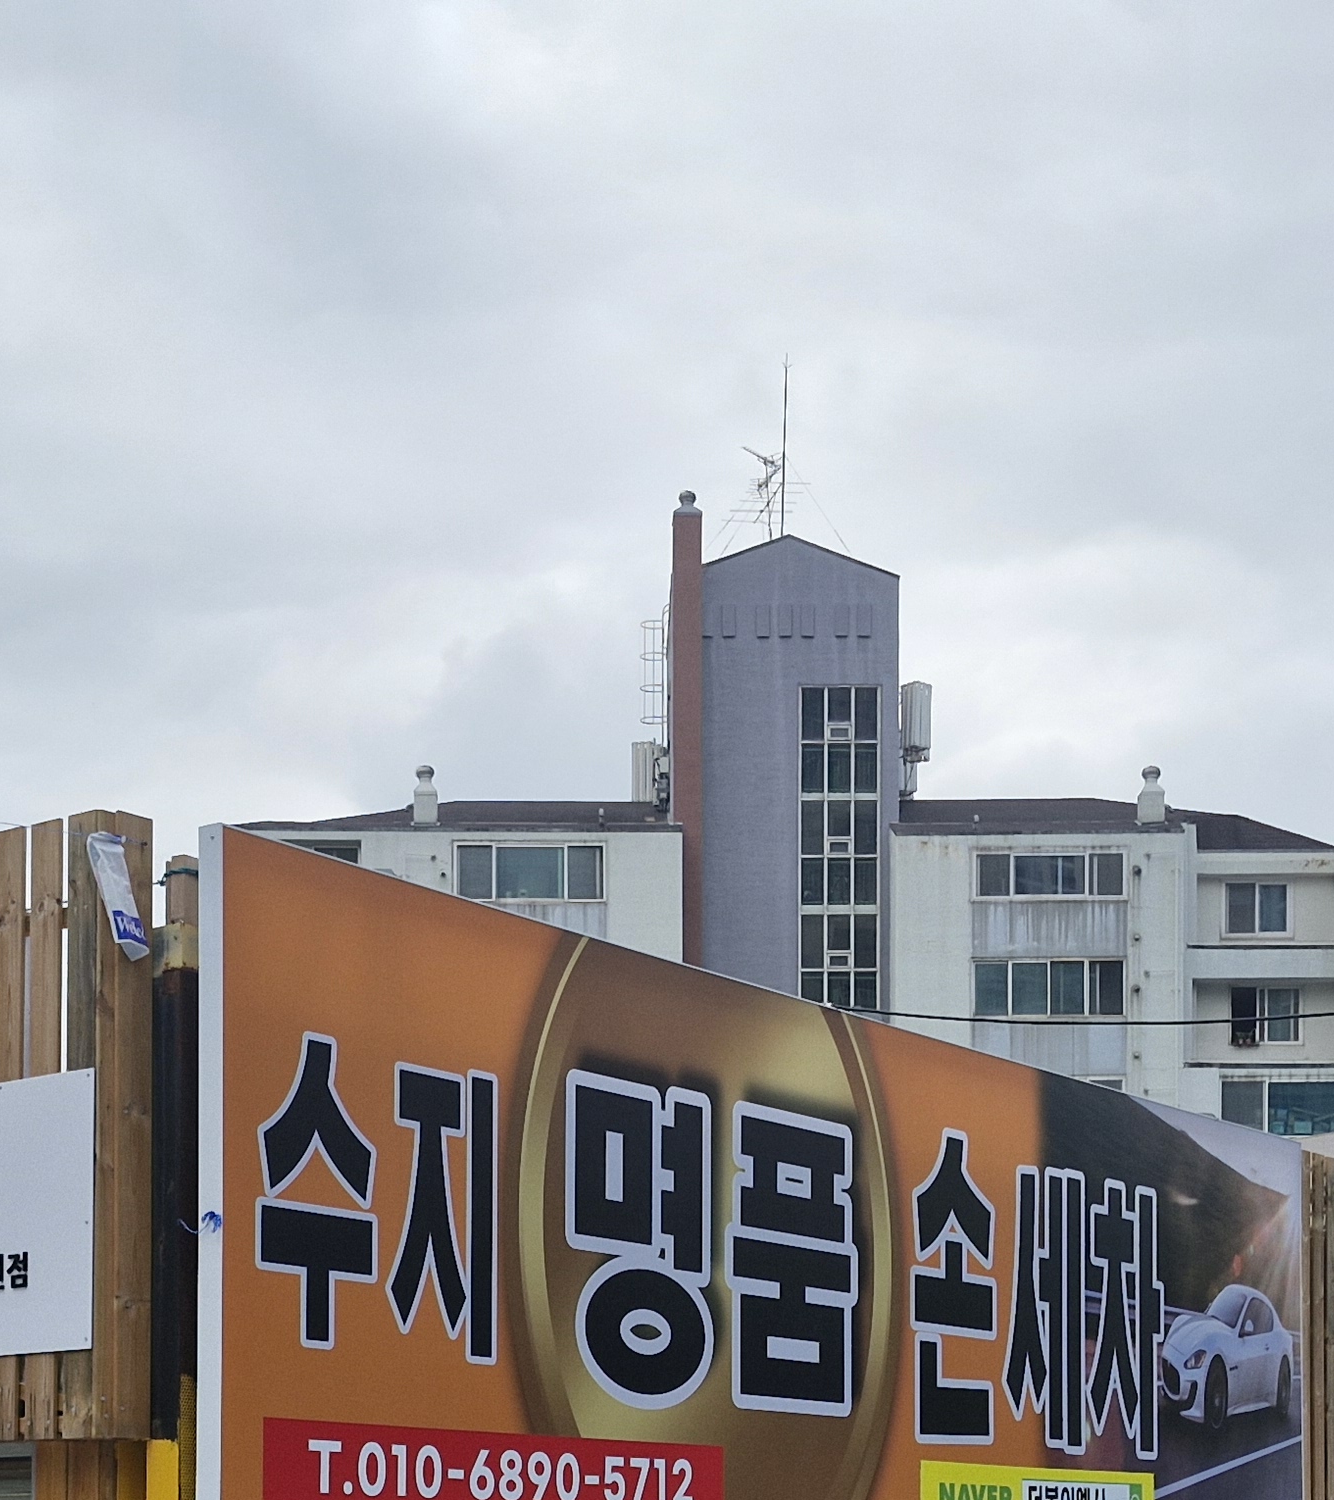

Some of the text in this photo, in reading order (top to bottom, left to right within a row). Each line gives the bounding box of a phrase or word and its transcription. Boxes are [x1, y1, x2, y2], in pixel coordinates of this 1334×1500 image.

[254, 1031, 1165, 1460] 수지 명품 손세차
